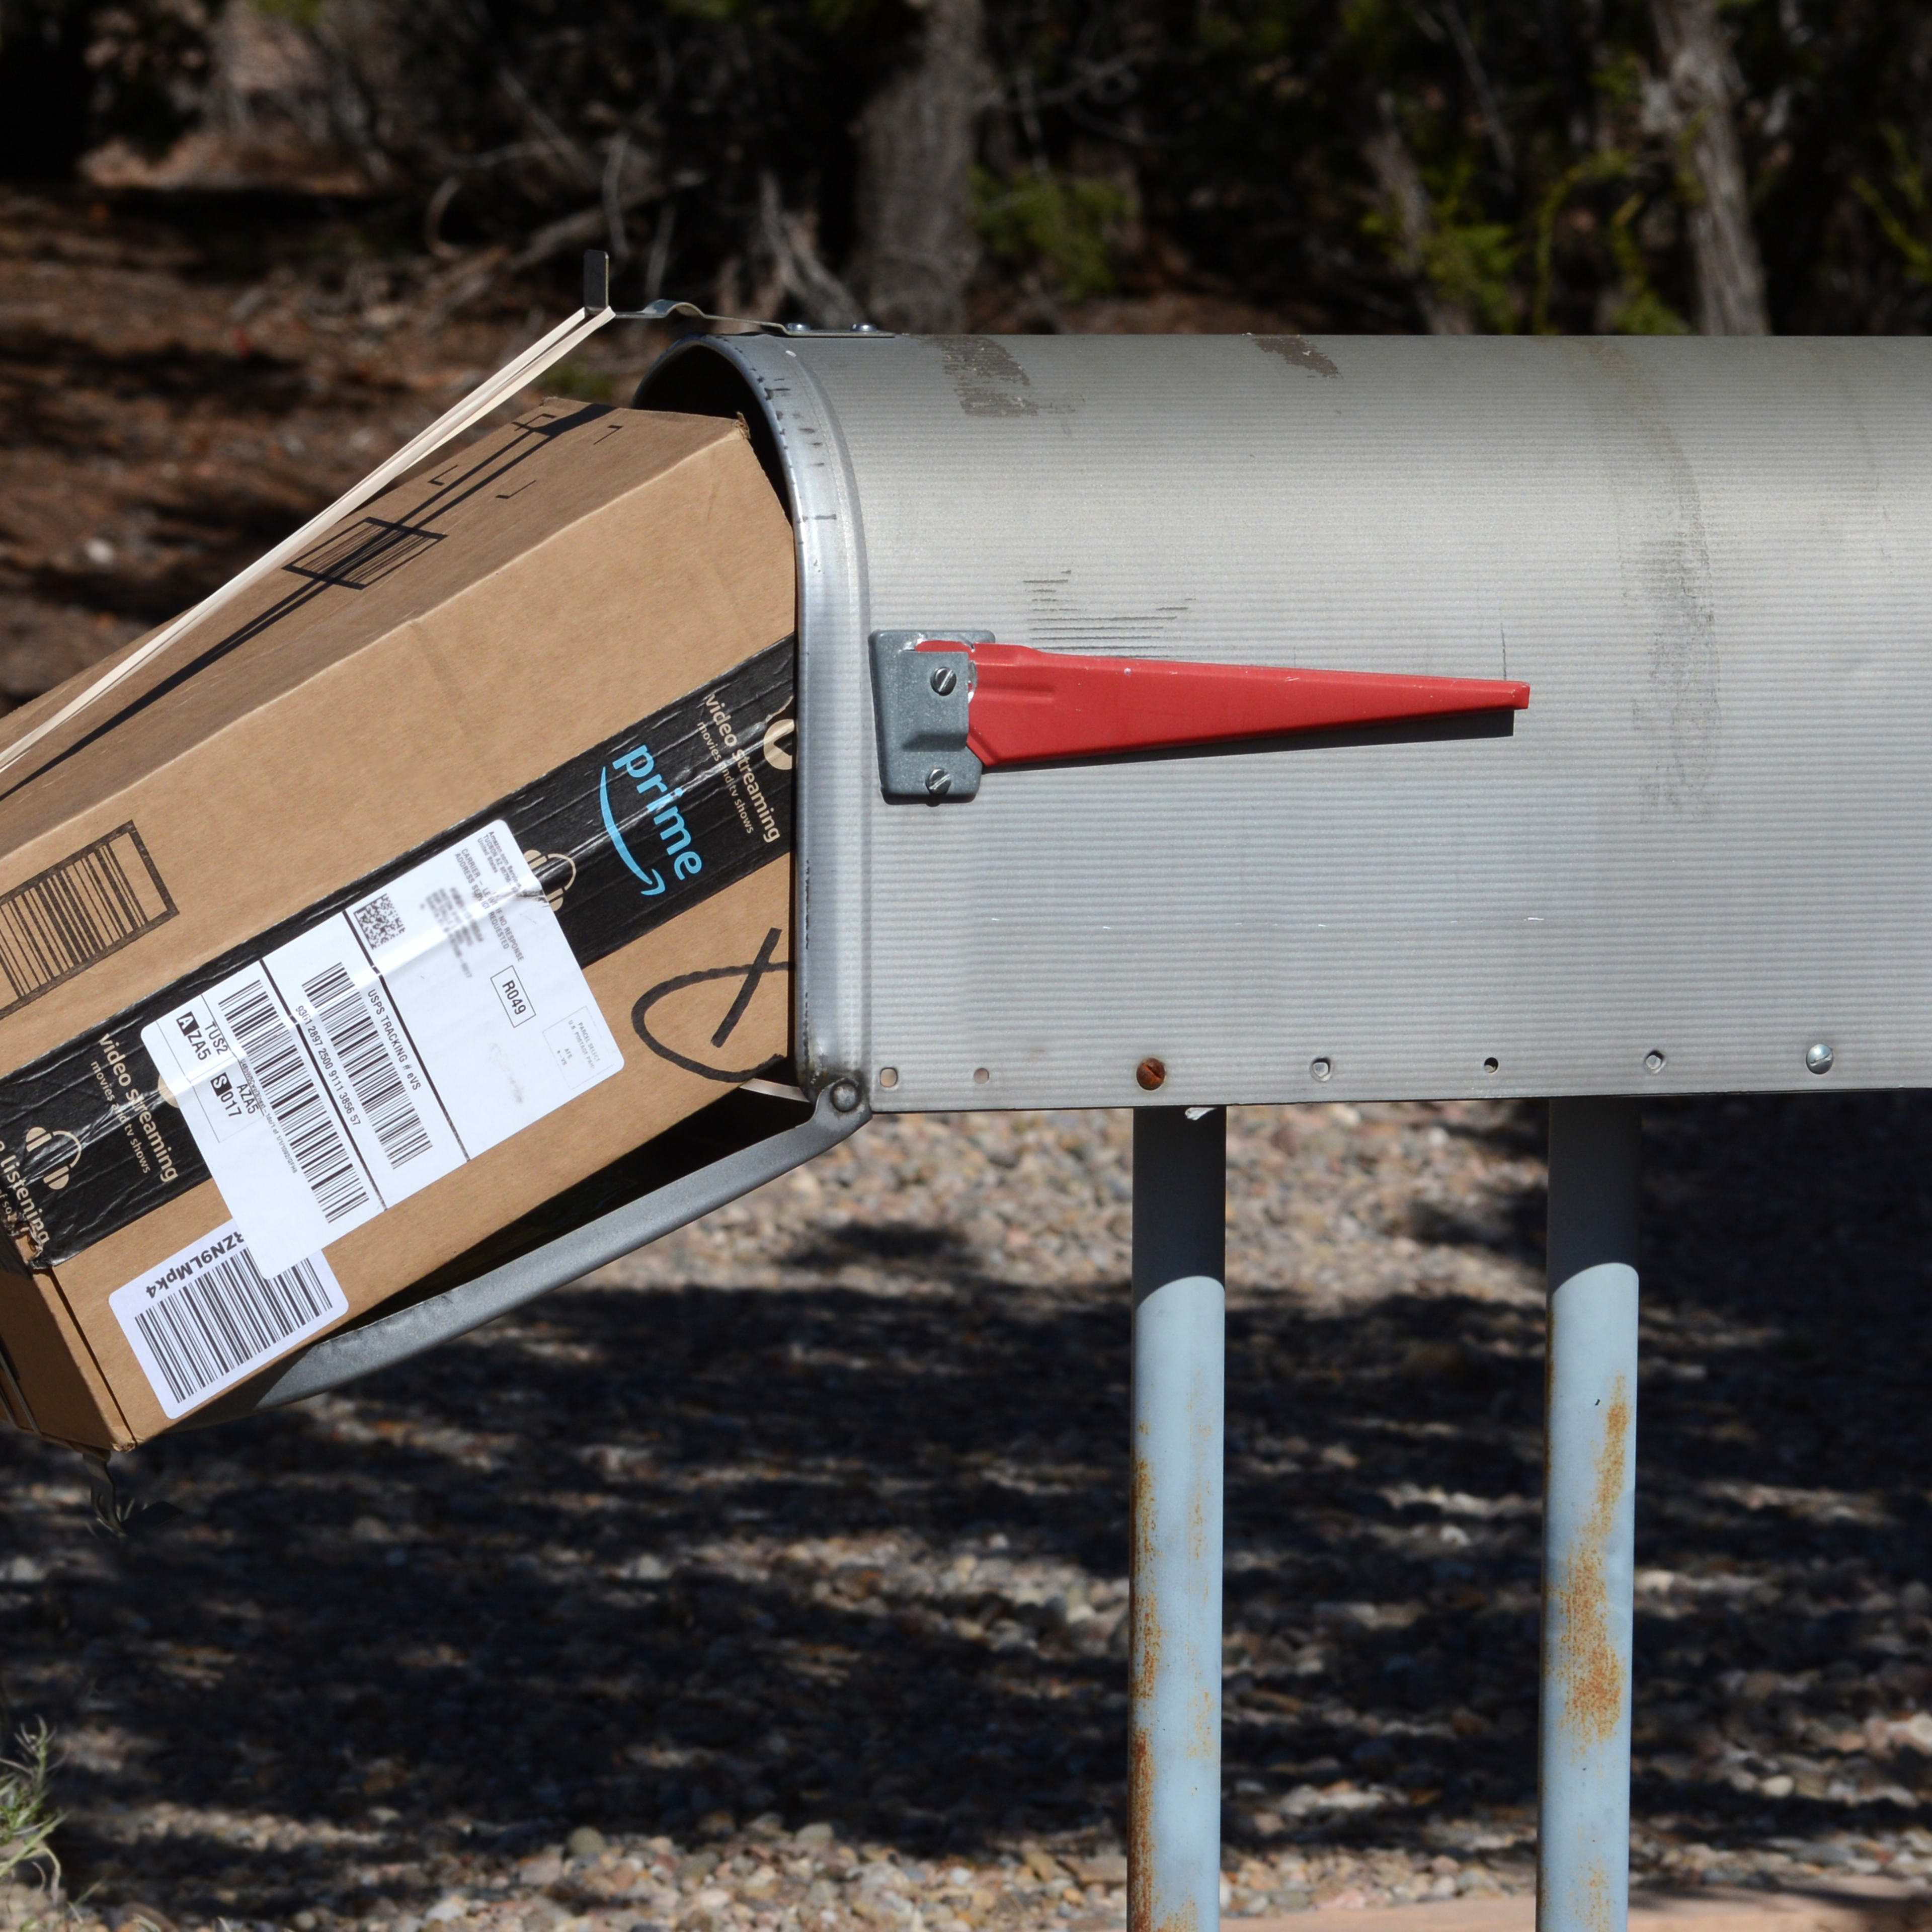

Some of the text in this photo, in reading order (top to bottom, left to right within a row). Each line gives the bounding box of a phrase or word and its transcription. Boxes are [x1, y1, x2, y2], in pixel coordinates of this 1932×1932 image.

[696, 721, 723, 762] movies
[704, 693, 782, 843] video streaming
[611, 744, 704, 880] prime
[728, 783, 739, 797] tv
[733, 798, 755, 835] shows
[454, 853, 474, 883] ADDRESS
[488, 912, 509, 949] REQUESTED
[477, 838, 498, 873] United States
[461, 848, 480, 878] CARRIER
[498, 916, 507, 926] NO
[504, 927, 524, 961] RESPONSE
[204, 1021, 229, 1055] TUS2
[367, 989, 385, 1015] USPS
[379, 1015, 408, 1063] TRACKING
[406, 1072, 421, 1091] eVS
[502, 980, 527, 1015] R049
[90, 1061, 115, 1102] movies
[123, 1123, 133, 1136] tv
[128, 1138, 151, 1174] shows
[98, 1033, 178, 1183] video streaming
[235, 1082, 259, 1114] AZA5
[307, 1025, 323, 1047] 2897
[317, 1048, 333, 1070] 2500
[328, 1070, 344, 1092] 9111
[339, 1092, 354, 1114] 3856
[350, 1114, 360, 1126] 57
